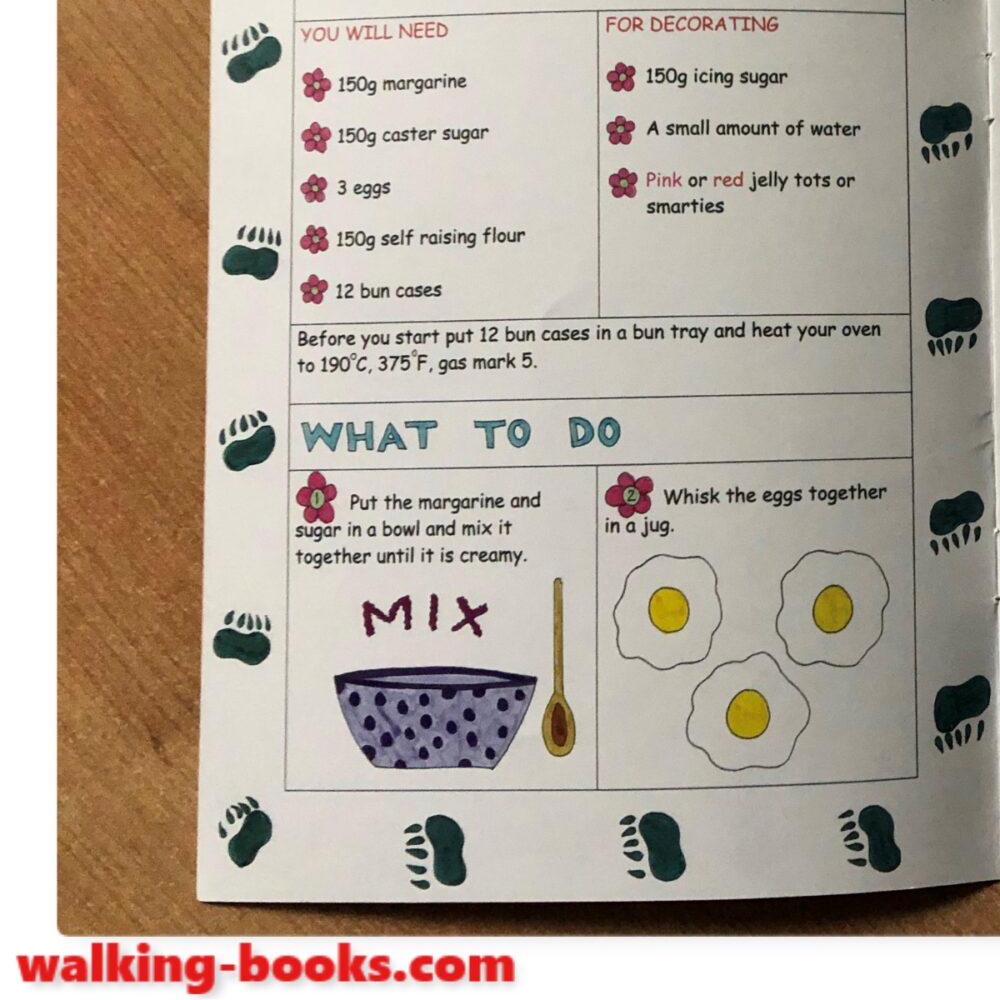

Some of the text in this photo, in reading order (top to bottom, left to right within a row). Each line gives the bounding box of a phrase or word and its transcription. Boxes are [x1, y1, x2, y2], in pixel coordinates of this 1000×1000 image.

[300, 21, 449, 42] YOU WILL NEED
[605, 14, 780, 33] FOR DECORATING
[338, 73, 468, 97] 150g margarine
[646, 67, 789, 89] 150g icing sugar
[337, 126, 490, 148] 150g caster sugar
[646, 118, 862, 137] A small amount of water
[337, 179, 391, 200] 3 eggs
[646, 170, 856, 193] Pink or red jelly tots or
[646, 197, 725, 215] smarties
[336, 226, 526, 252] 150g self raising flour
[335, 282, 443, 300] 12 bun cases
[296, 358, 316, 374] to
[438, 356, 468, 376] gas
[472, 352, 517, 370] mark
[521, 351, 538, 369] 5.
[302, 416, 622, 454] WHAT TO DO
[314, 490, 542, 515] 1 Put the margarine and
[627, 482, 888, 508] 2 Whisk the eggs together
[604, 516, 675, 539] in a jug.
[361, 593, 489, 638] MIX
